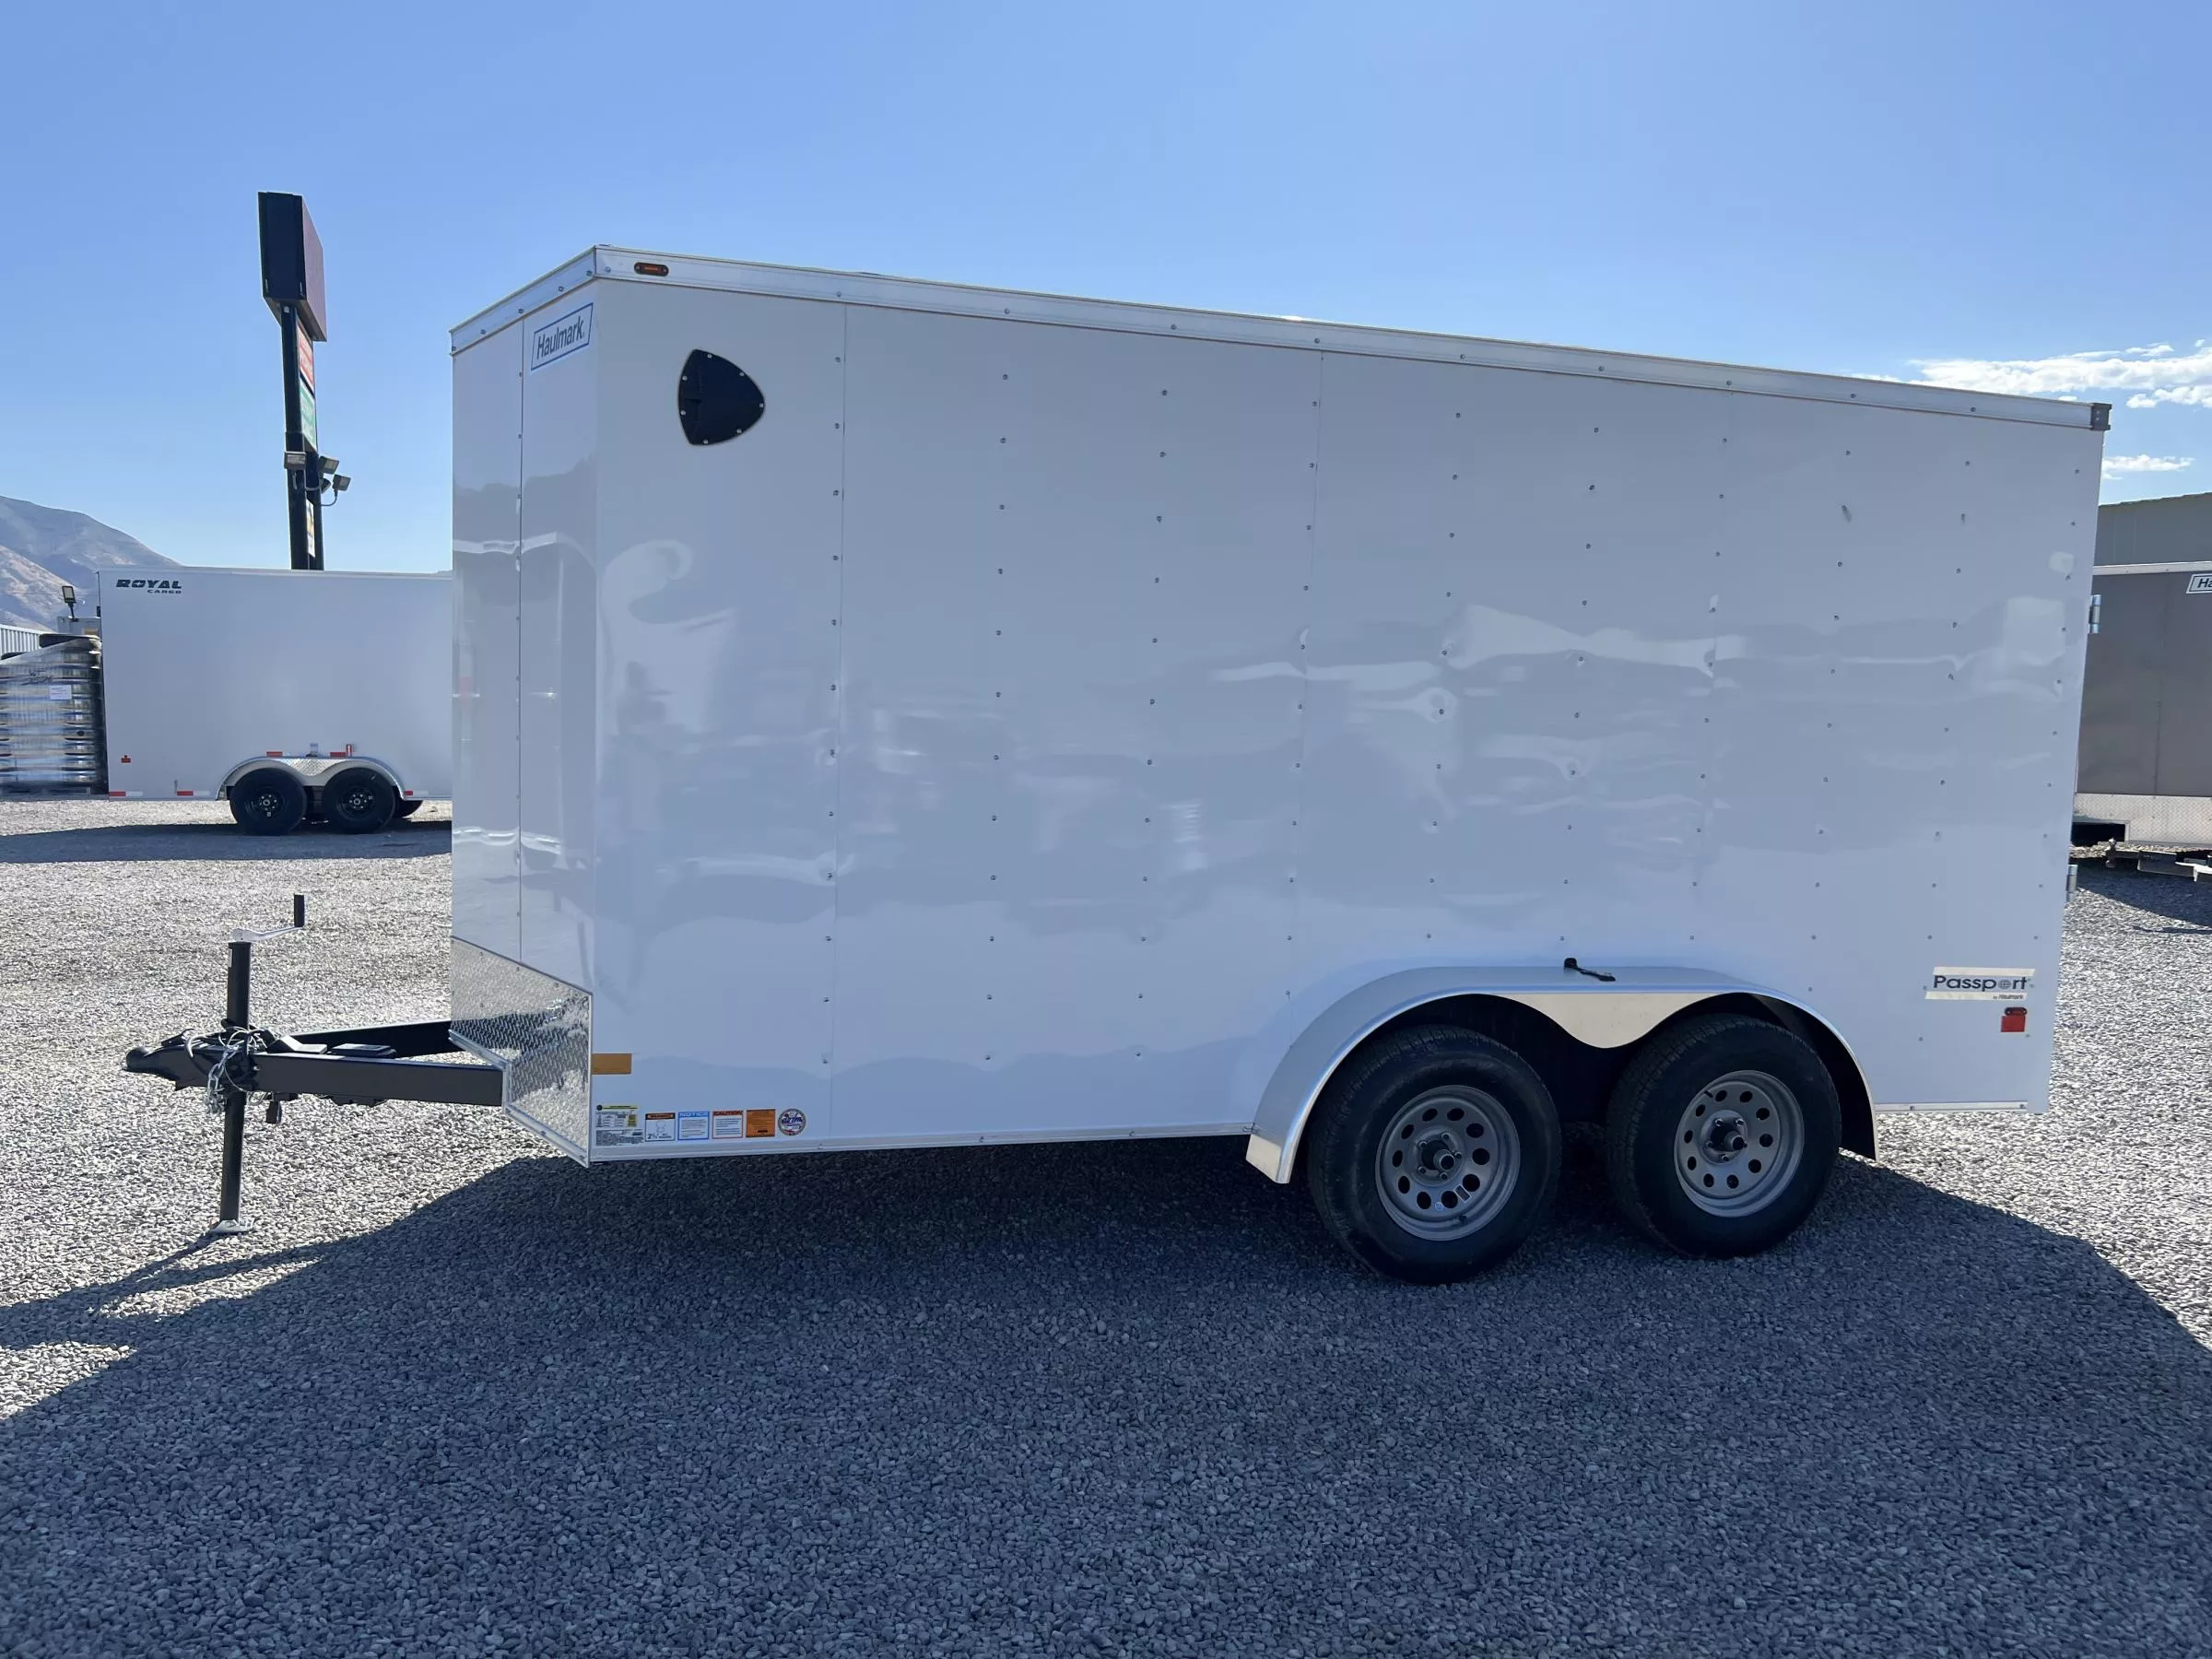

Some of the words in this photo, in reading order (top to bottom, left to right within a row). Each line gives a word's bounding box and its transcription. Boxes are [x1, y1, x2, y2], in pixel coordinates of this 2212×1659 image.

[536, 315, 583, 359] Haulmark
[116, 579, 182, 589] ROYAL
[1934, 975, 2027, 992] Passport
